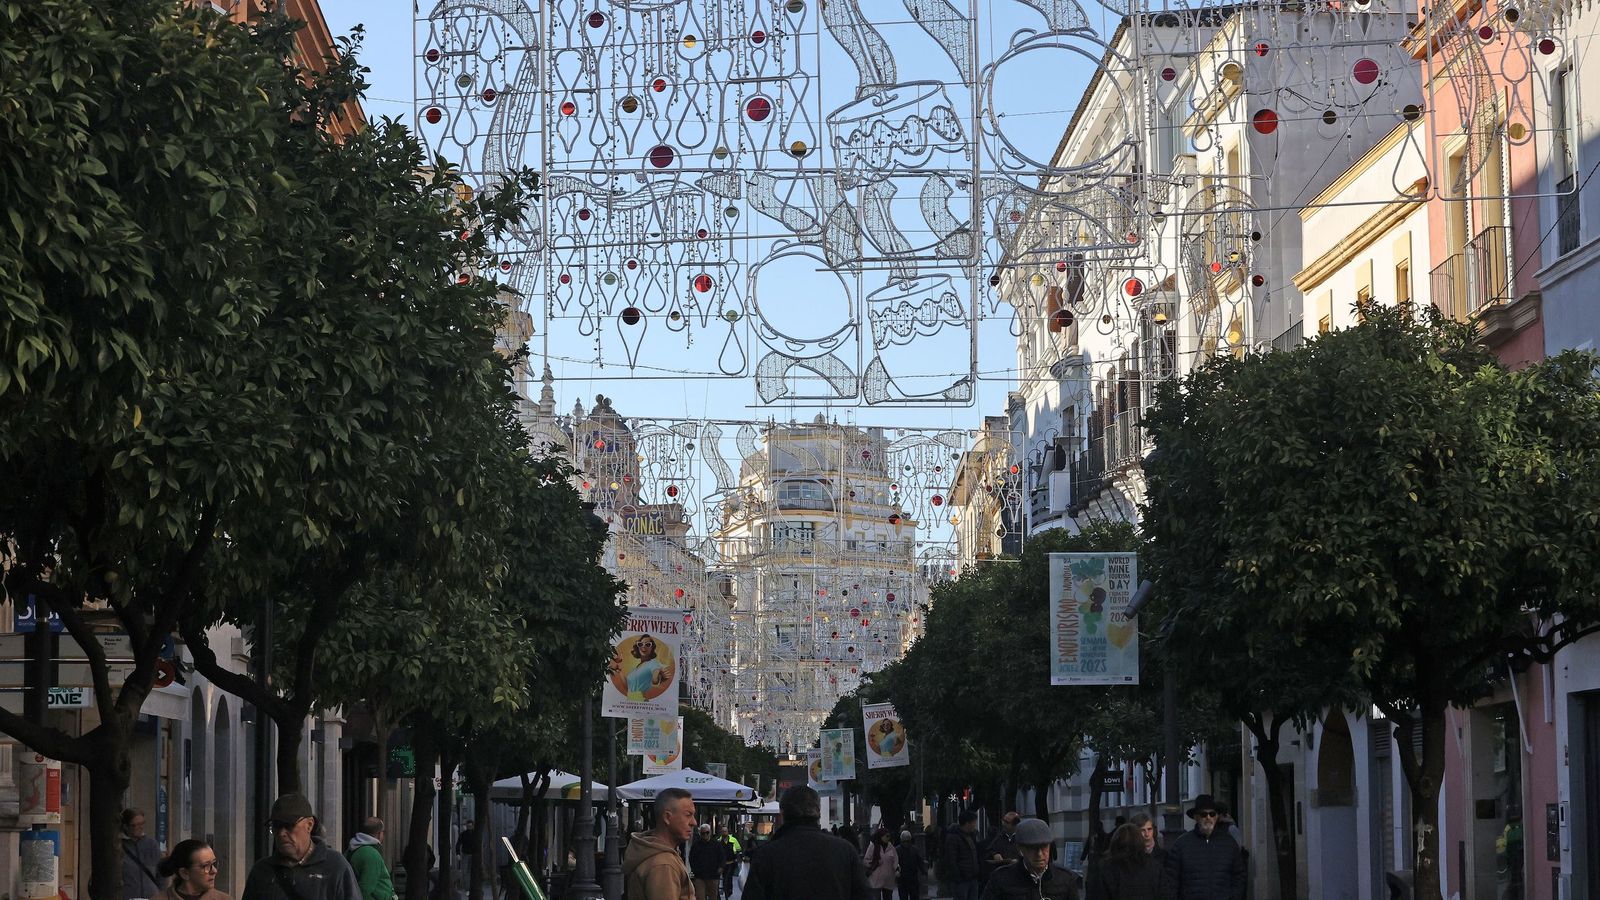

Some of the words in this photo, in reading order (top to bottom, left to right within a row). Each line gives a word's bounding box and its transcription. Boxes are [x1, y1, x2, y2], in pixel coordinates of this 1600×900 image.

[626, 513, 663, 535] COÑAC
[1108, 556, 1130, 565] WORLD
[1108, 565, 1130, 574] WINE
[1109, 580, 1130, 590] DAY
[624, 618, 679, 635] ERRYWEEK
[1057, 599, 1079, 665] ENOTURISMO
[1080, 659, 1107, 673] 2025
